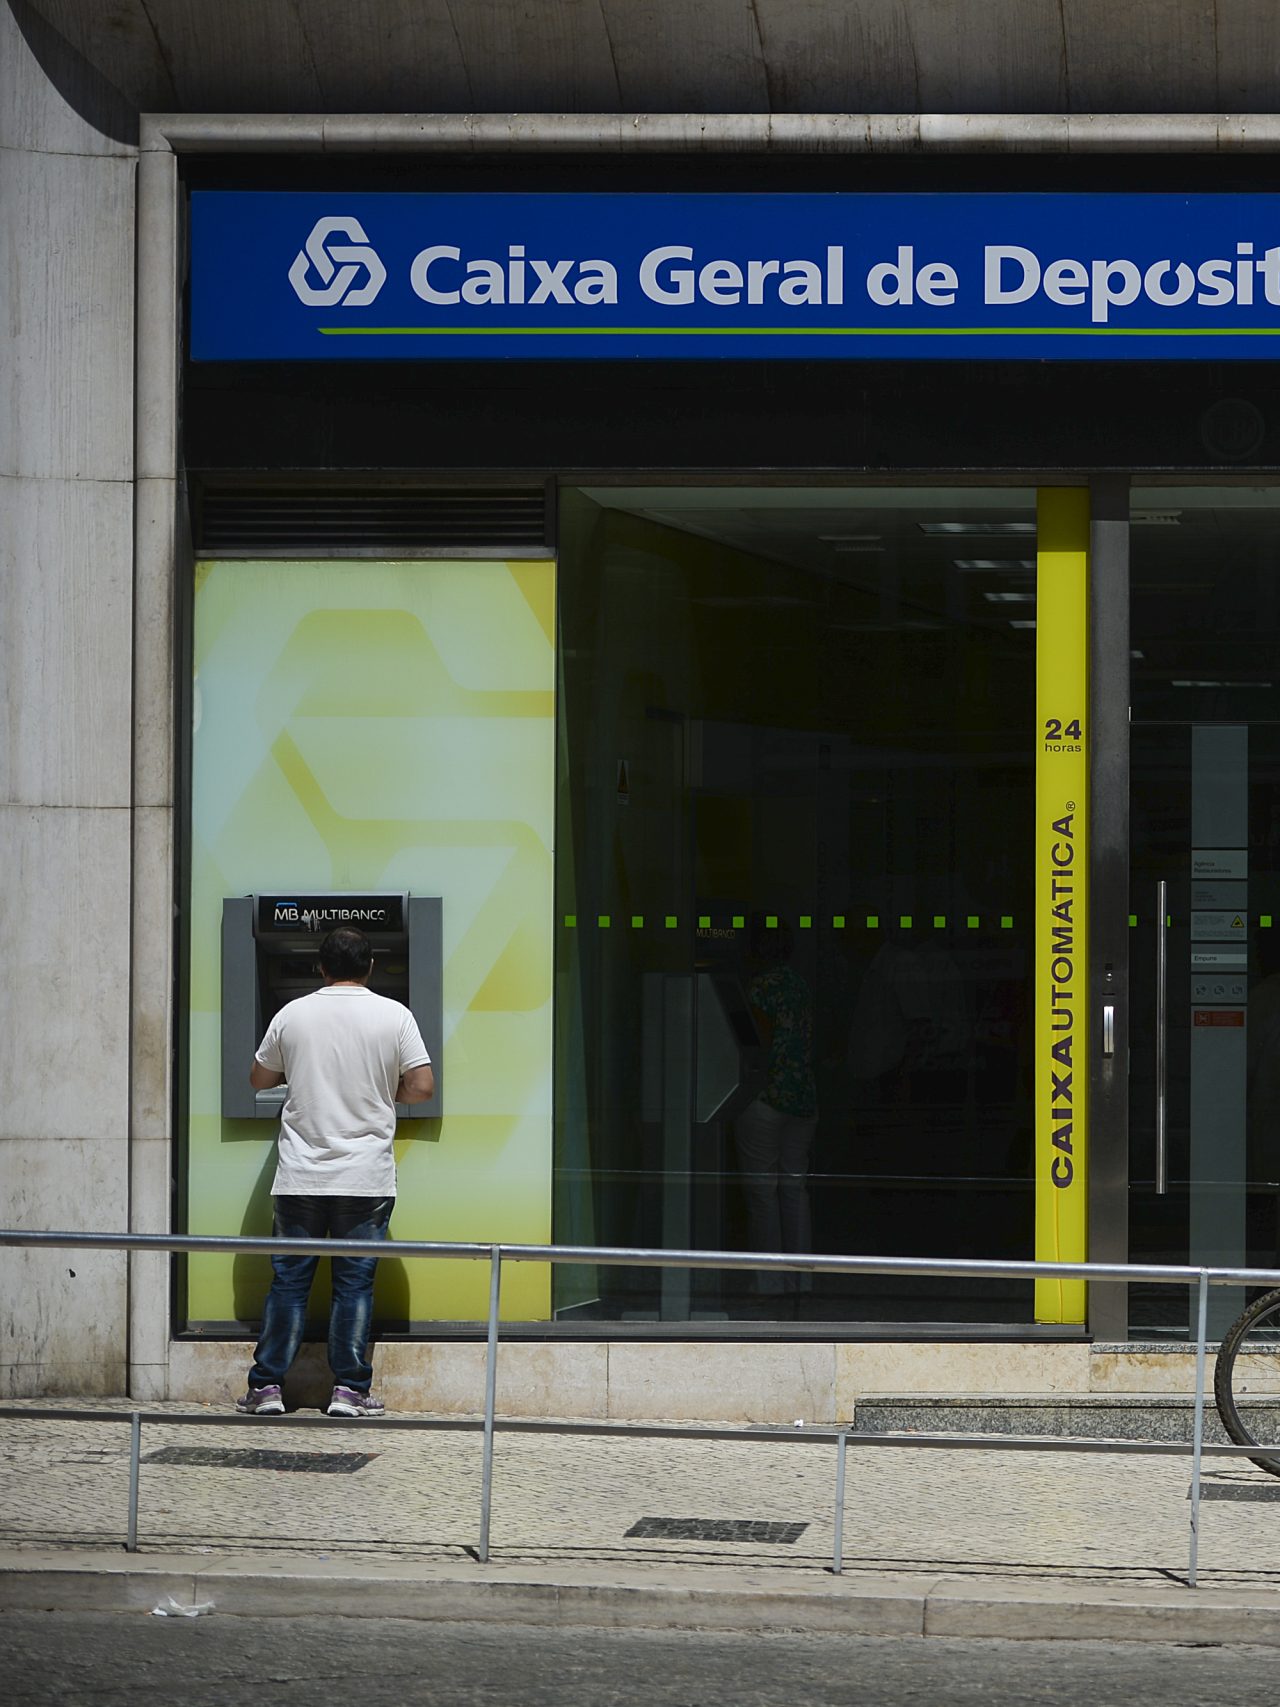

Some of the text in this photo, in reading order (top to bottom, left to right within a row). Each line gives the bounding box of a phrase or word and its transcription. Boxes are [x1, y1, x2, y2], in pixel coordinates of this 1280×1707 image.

[411, 245, 617, 305] Caixa
[640, 245, 843, 305] Geral
[867, 245, 958, 305] de
[1045, 718, 1082, 741] 24
[1045, 743, 1082, 753] horas
[274, 908, 299, 921] MB
